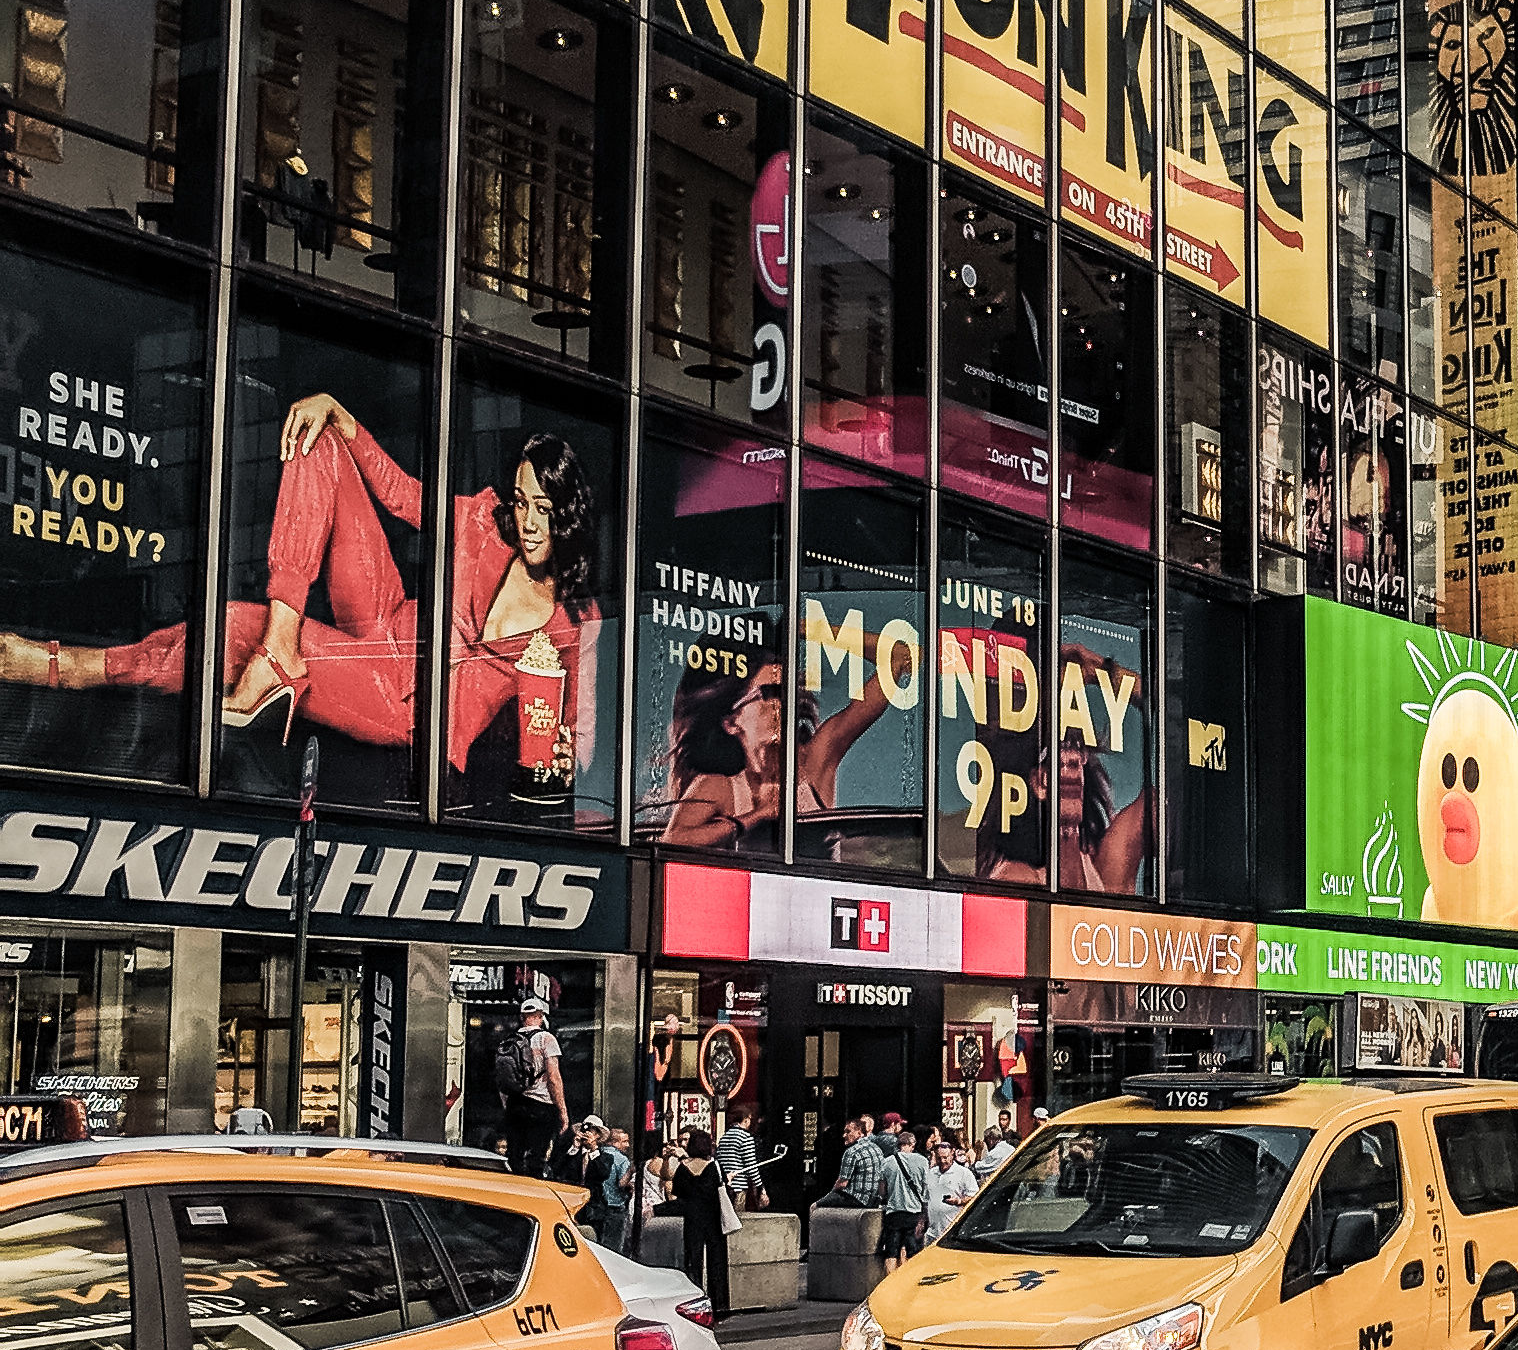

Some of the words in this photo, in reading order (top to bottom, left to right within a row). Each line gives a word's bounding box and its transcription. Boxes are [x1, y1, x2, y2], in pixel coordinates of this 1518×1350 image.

[951, 123, 1042, 188] ENTRANCE
[1068, 181, 1096, 216] ON
[1106, 200, 1147, 241] 45TH
[1166, 232, 1213, 276] STREET
[49, 372, 125, 418] SHE
[18, 407, 160, 469] READY.
[46, 466, 125, 511] YOU
[12, 503, 166, 563] READY?
[656, 561, 760, 610] TIFFANY
[942, 577, 1003, 619] JUNE
[1012, 595, 1036, 627] 18
[652, 600, 764, 646] HADDISH
[669, 640, 748, 679] HOSTS
[804, 599, 1136, 753] MONDAY
[1188, 718, 1227, 771] MTV
[955, 740, 1028, 833] 9P
[0, 811, 601, 933] SKECHERS
[1320, 871, 1355, 897] SALLY
[1072, 922, 1148, 970] GOLD
[1154, 928, 1242, 977] WAVES
[1327, 947, 1368, 982] LINE
[1371, 951, 1442, 987] FRIENDS
[1466, 959, 1500, 990] NEW
[847, 985, 912, 1007] TISSOT
[1135, 985, 1187, 1013] KIKO
[369, 969, 394, 1138] SKECH
[36, 1076, 139, 1090] SKECHERS
[1165, 1091, 1209, 1108] 1Y65
[514, 1303, 560, 1336] 6C71
